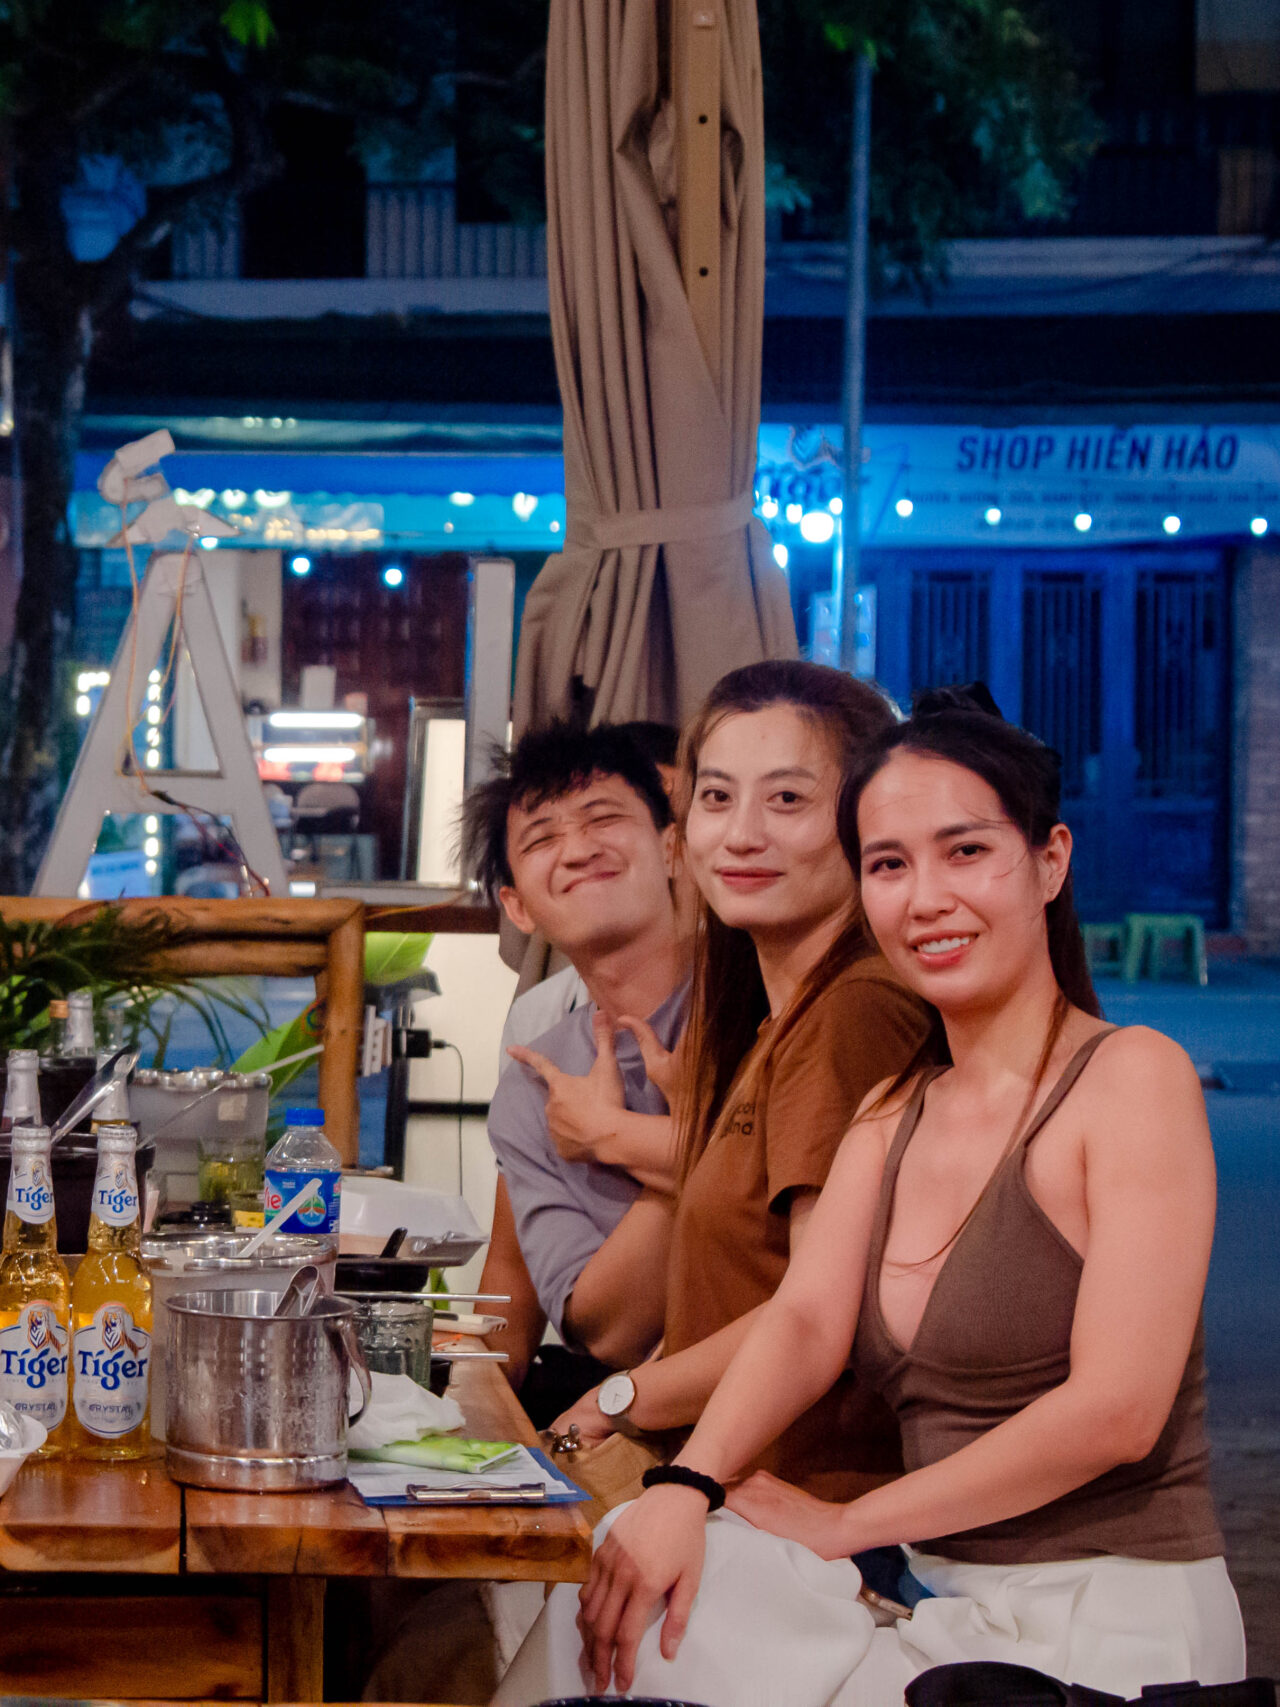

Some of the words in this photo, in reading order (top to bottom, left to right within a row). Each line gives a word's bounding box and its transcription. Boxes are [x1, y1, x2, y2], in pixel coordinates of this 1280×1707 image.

[956, 434, 1055, 472] SHOP
[15, 1186, 53, 1211] Tiger
[98, 1189, 138, 1213] Tiger
[0, 1347, 68, 1389] Tiger
[78, 1349, 148, 1391] Tiger
